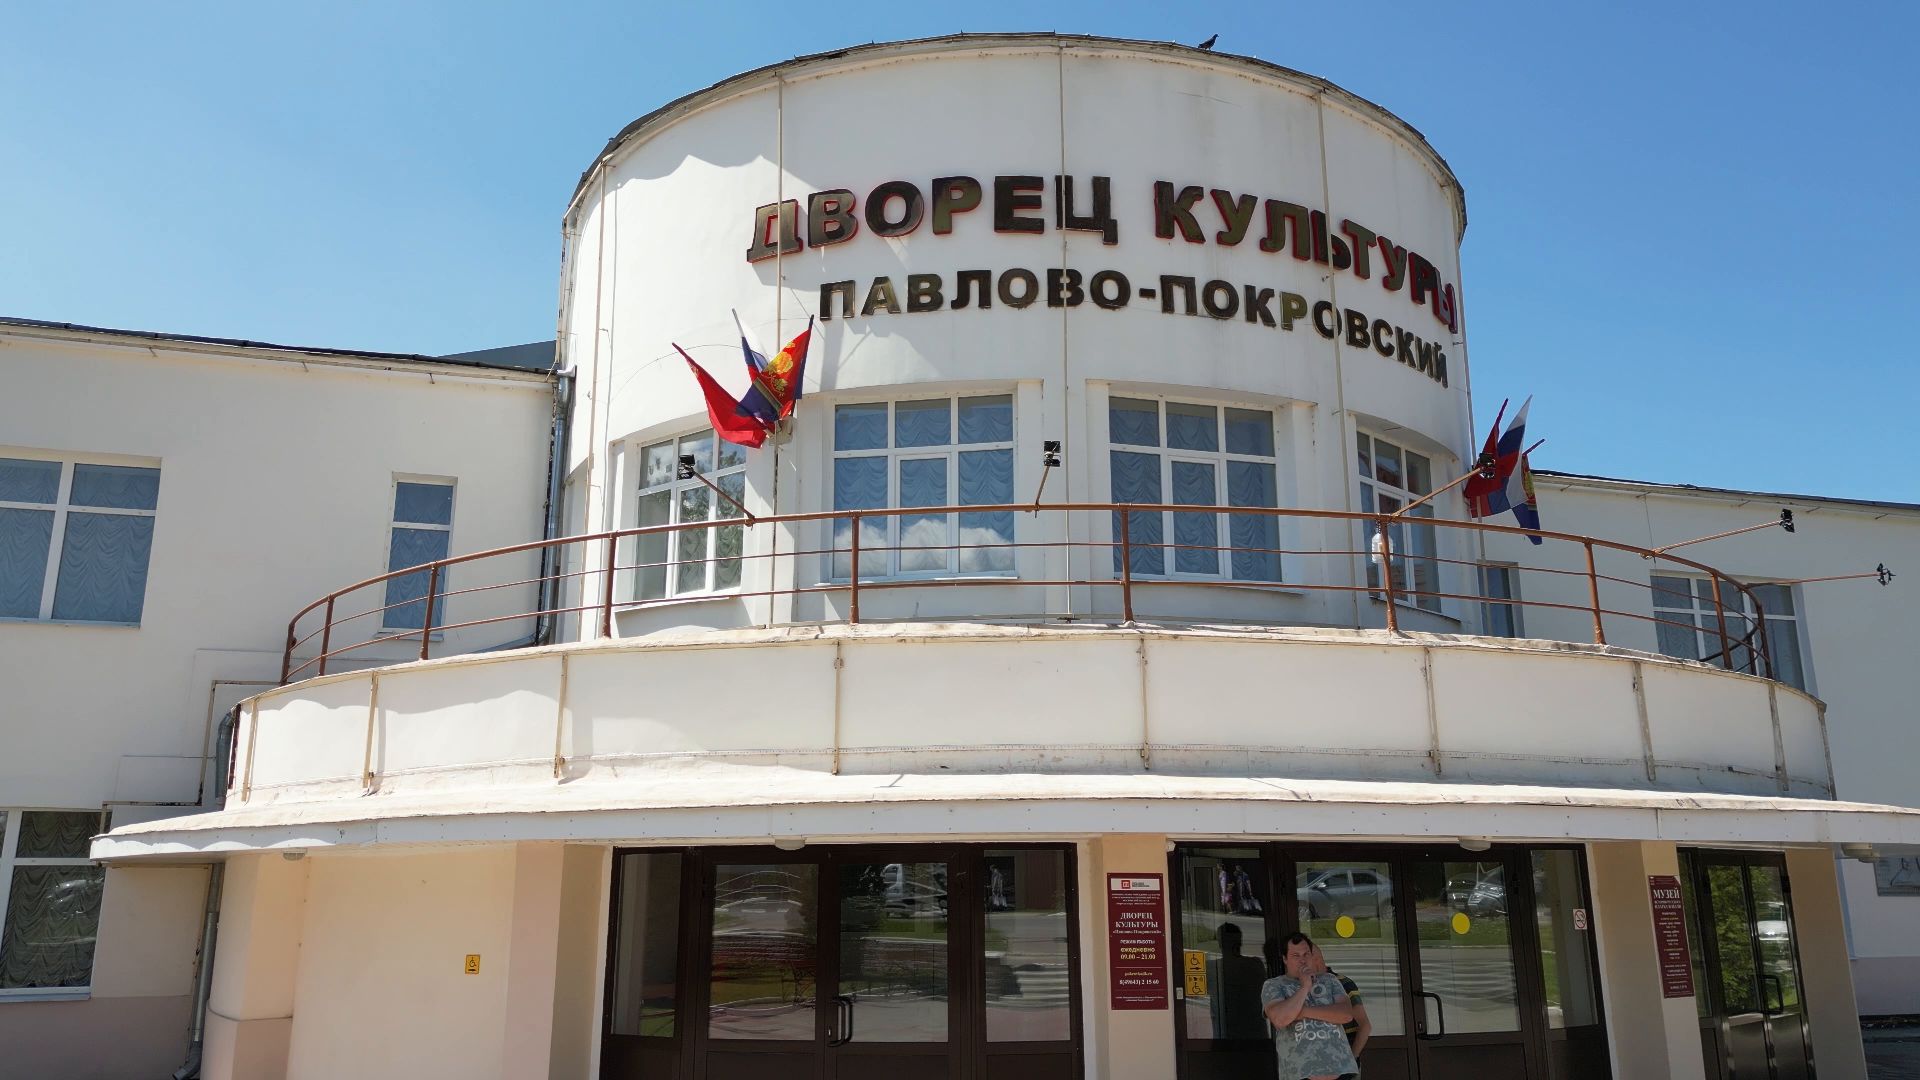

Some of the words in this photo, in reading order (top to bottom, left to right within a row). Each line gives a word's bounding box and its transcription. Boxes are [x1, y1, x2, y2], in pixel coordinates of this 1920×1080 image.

[746, 175, 1119, 263] ДВОРЕЦ
[1153, 180, 1459, 334] КУЛЬТУРЫ
[819, 268, 1449, 388] ПАВЛОВО-ПОКРОВСКИЙ
[1653, 887, 1680, 899] МУЗЕЙ
[1120, 912, 1153, 920] ДВОРЕЦ
[1115, 921, 1158, 929] КУЛЬТУРЫ
